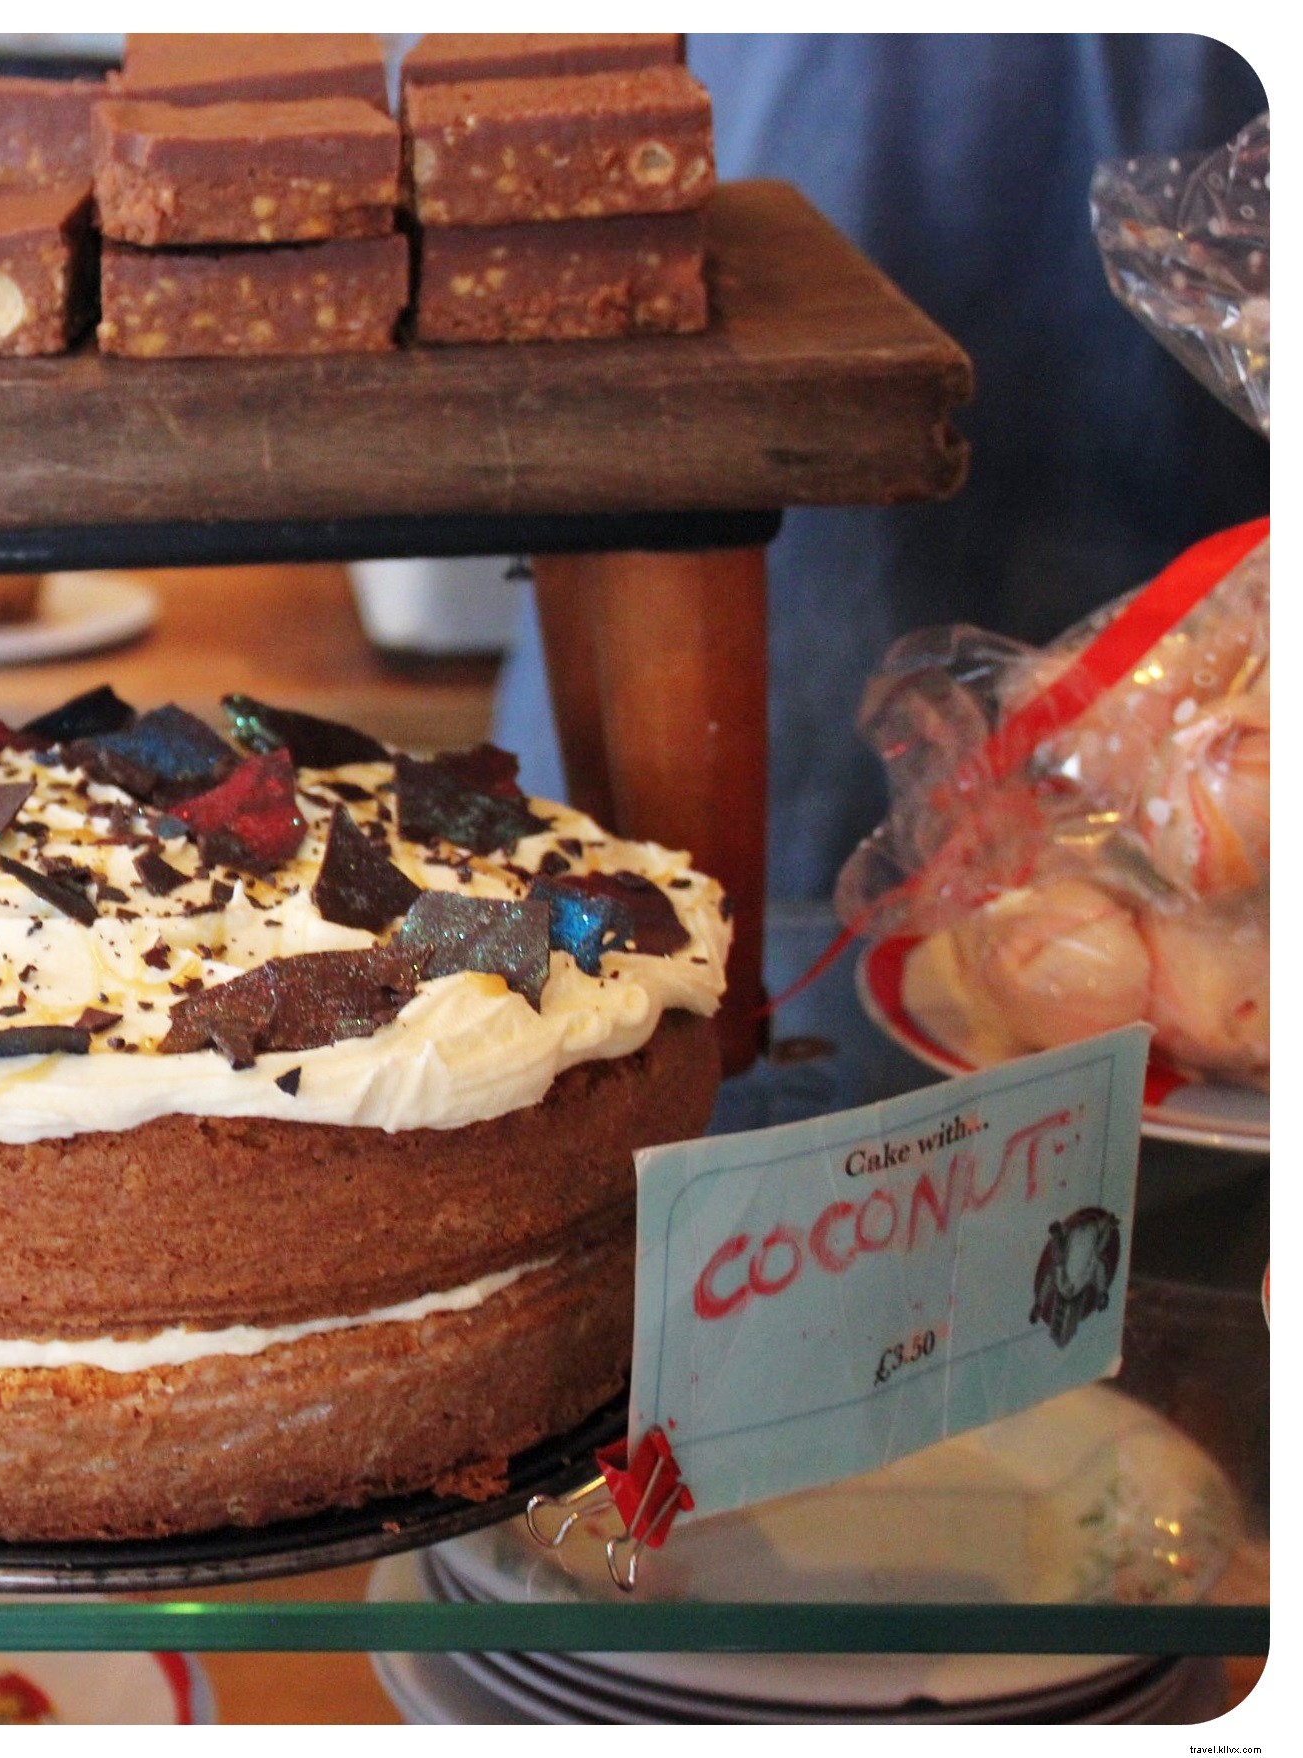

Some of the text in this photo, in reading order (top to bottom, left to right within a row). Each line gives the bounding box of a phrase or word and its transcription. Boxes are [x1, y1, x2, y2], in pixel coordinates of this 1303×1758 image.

[845, 1115, 989, 1177] Cake with...
[874, 1330, 936, 1387] £3.50
